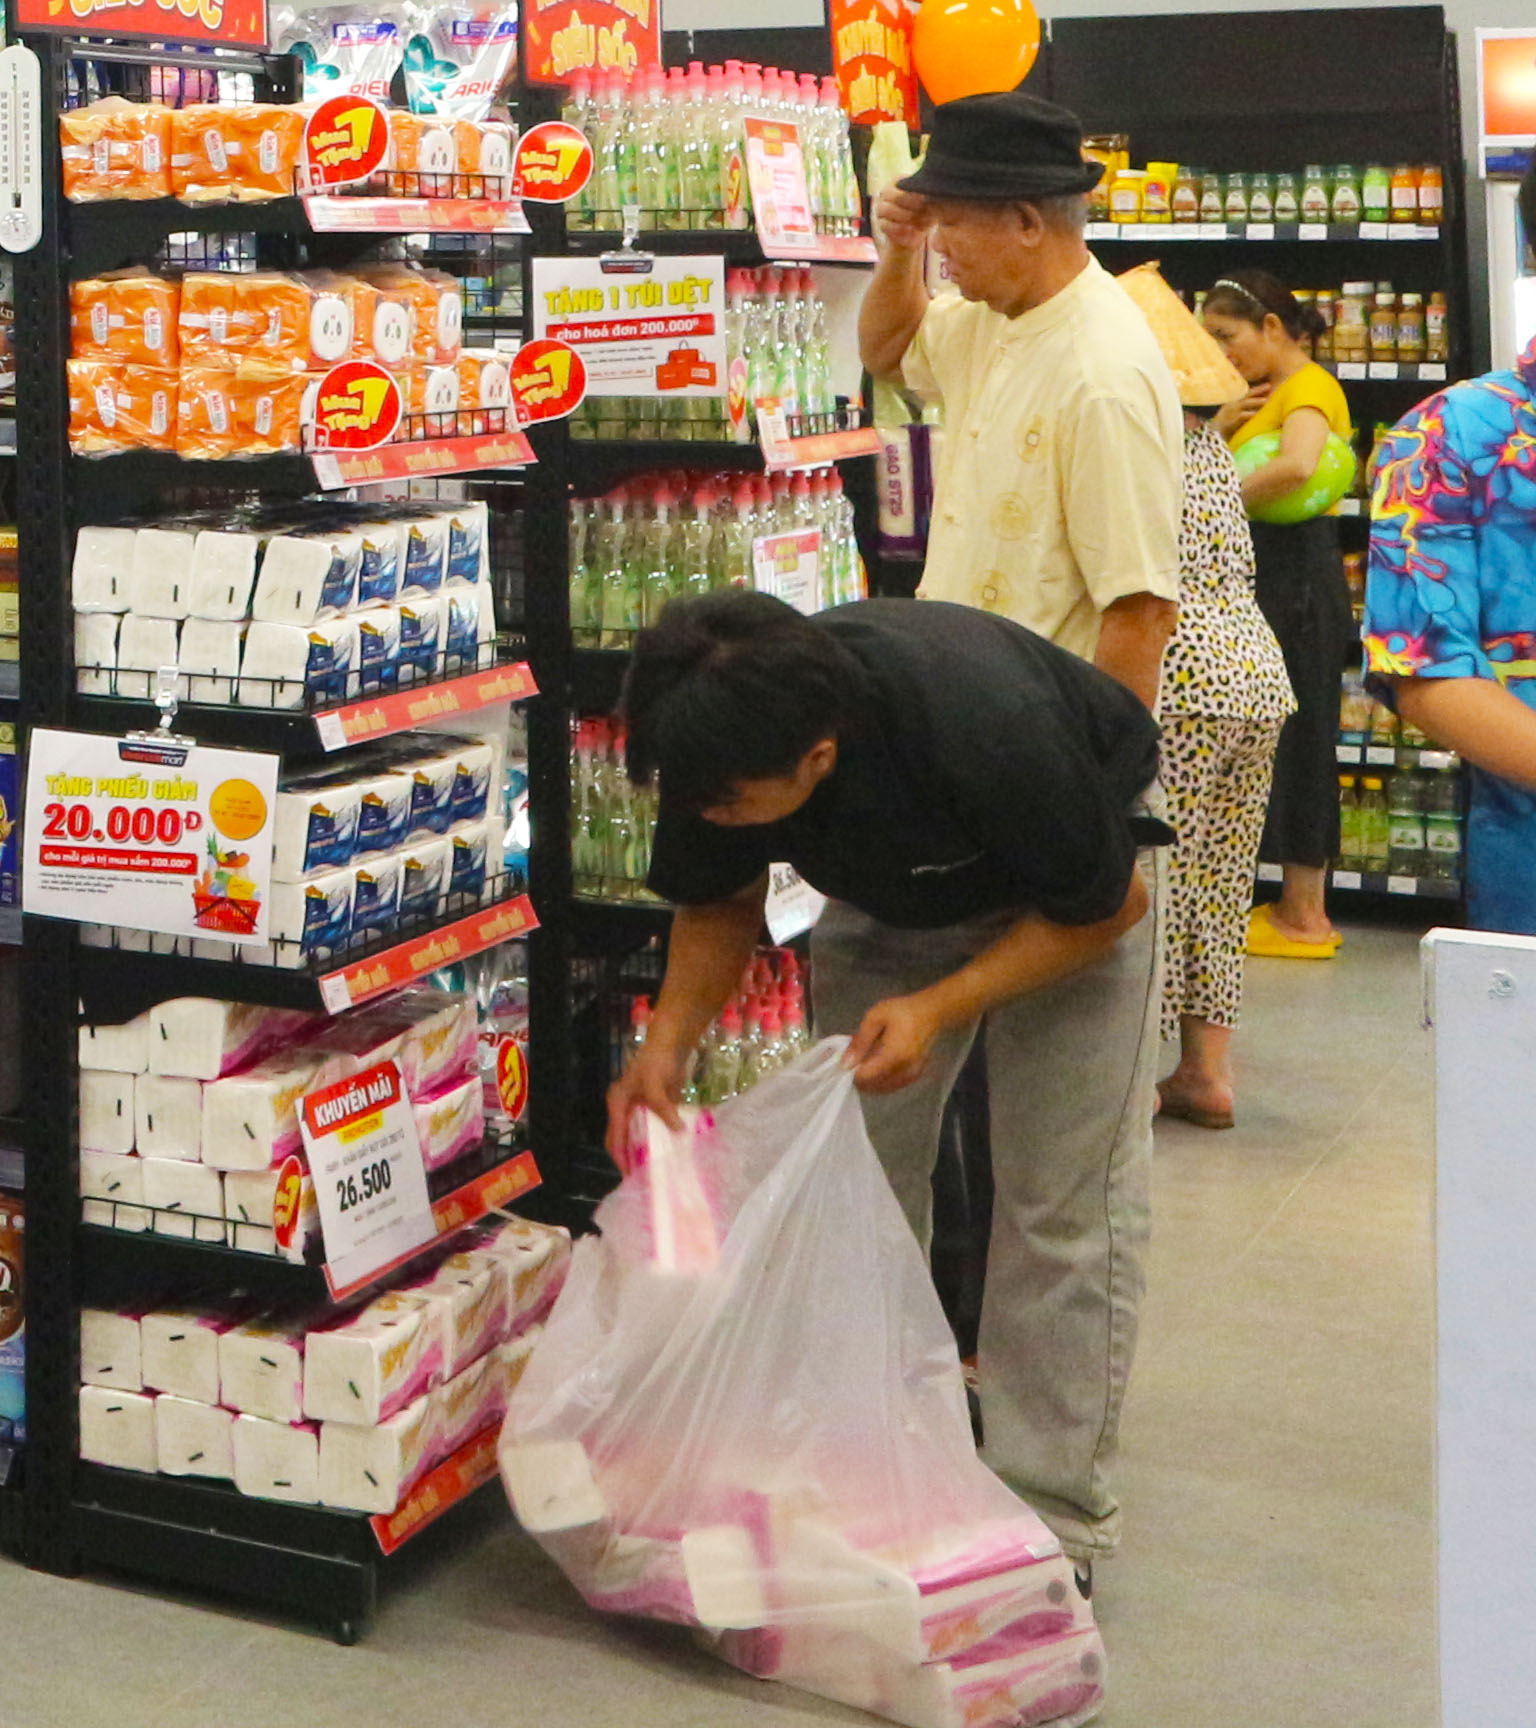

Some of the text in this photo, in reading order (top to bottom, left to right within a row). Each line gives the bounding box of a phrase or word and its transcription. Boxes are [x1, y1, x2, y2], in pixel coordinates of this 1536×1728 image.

[556, 327, 581, 341] cho
[584, 324, 609, 338] hoá
[612, 323, 638, 336] đơn
[314, 1073, 393, 1128] KHUYẾN MÃI
[336, 1158, 391, 1212] 26.500
